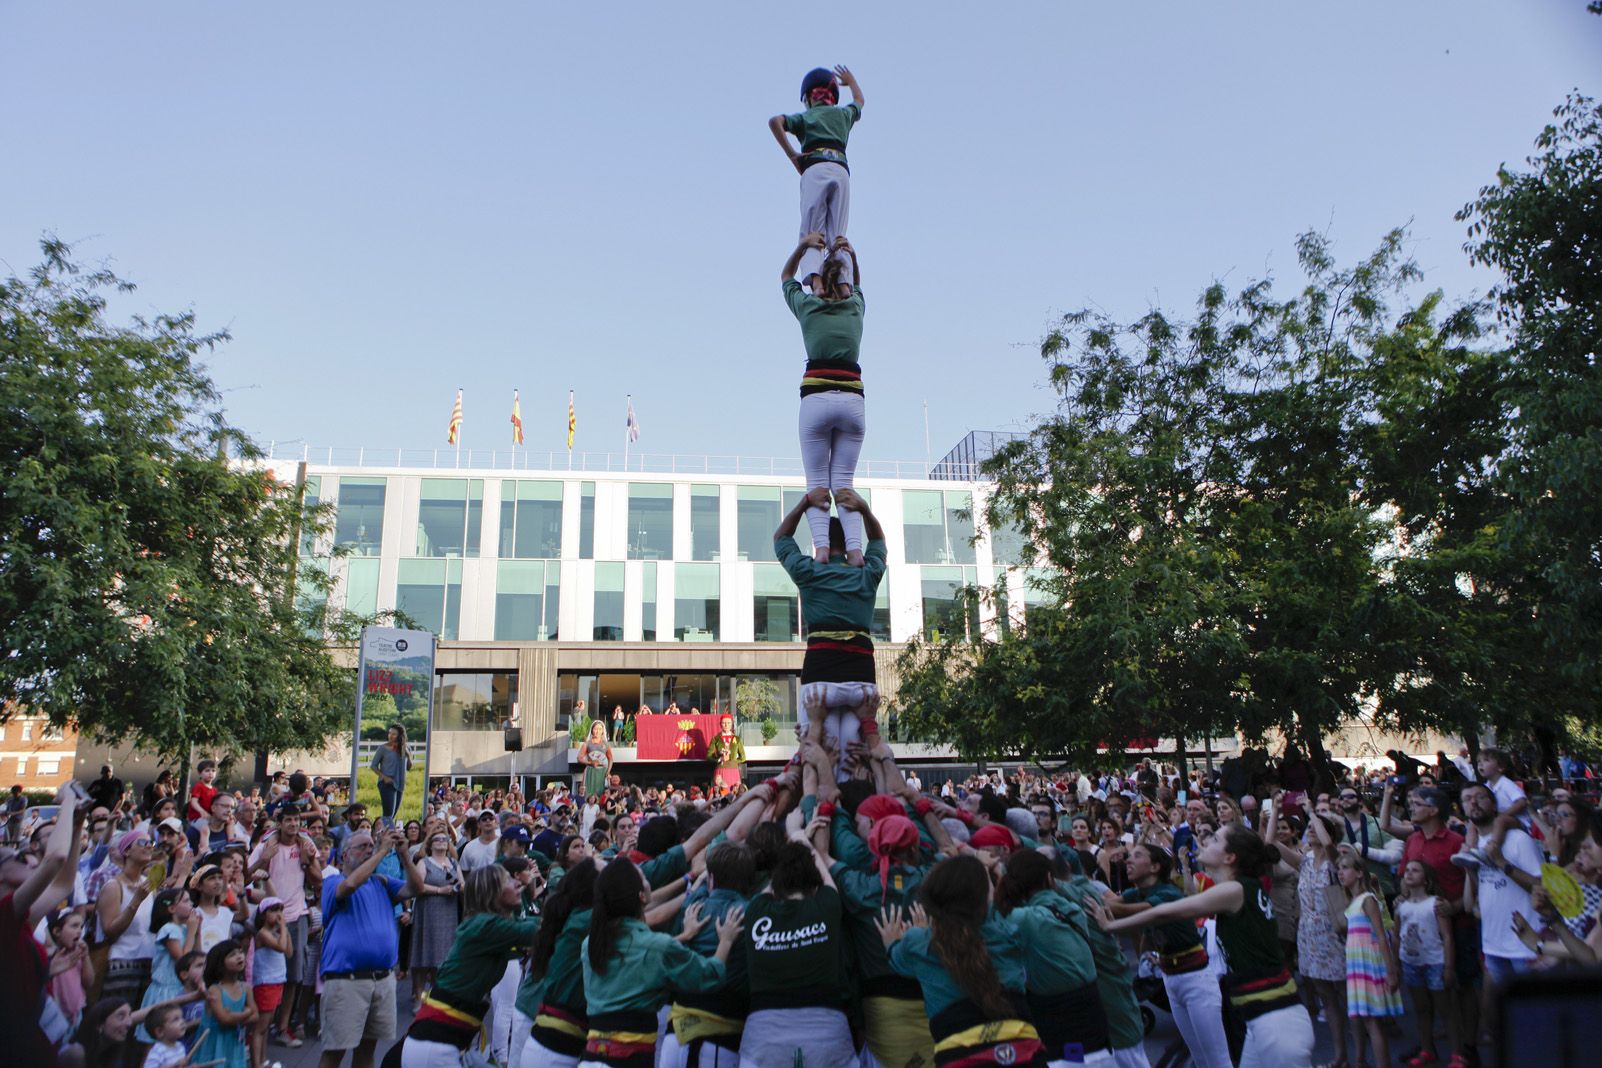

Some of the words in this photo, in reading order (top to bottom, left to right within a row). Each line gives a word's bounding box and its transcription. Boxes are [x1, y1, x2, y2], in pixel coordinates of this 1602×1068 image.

[367, 669, 393, 681] LIZZ
[367, 681, 414, 697] WRIGHT
[751, 916, 827, 950] Gausacs
